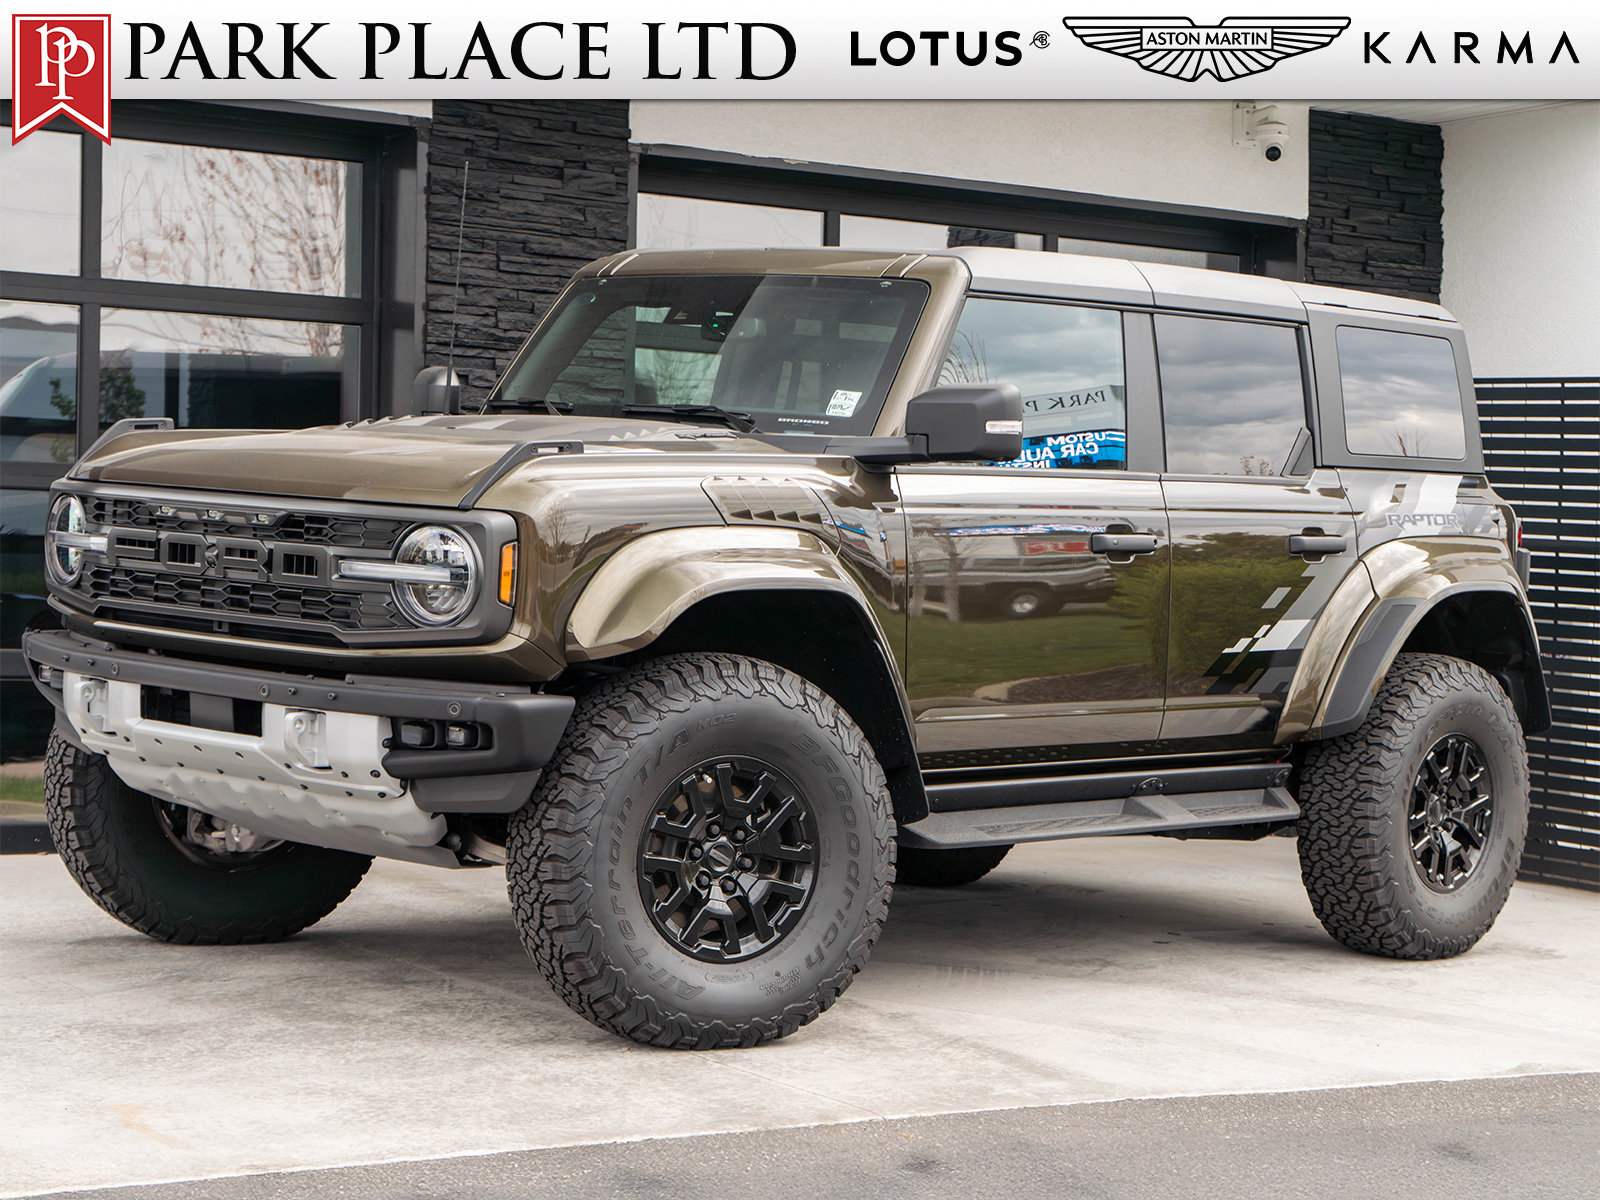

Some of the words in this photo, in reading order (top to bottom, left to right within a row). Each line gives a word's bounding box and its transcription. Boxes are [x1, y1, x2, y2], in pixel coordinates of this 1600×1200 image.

[1386, 513, 1460, 527] RAPTOR
[106, 525, 332, 587] FORD
[633, 727, 691, 786] T/A
